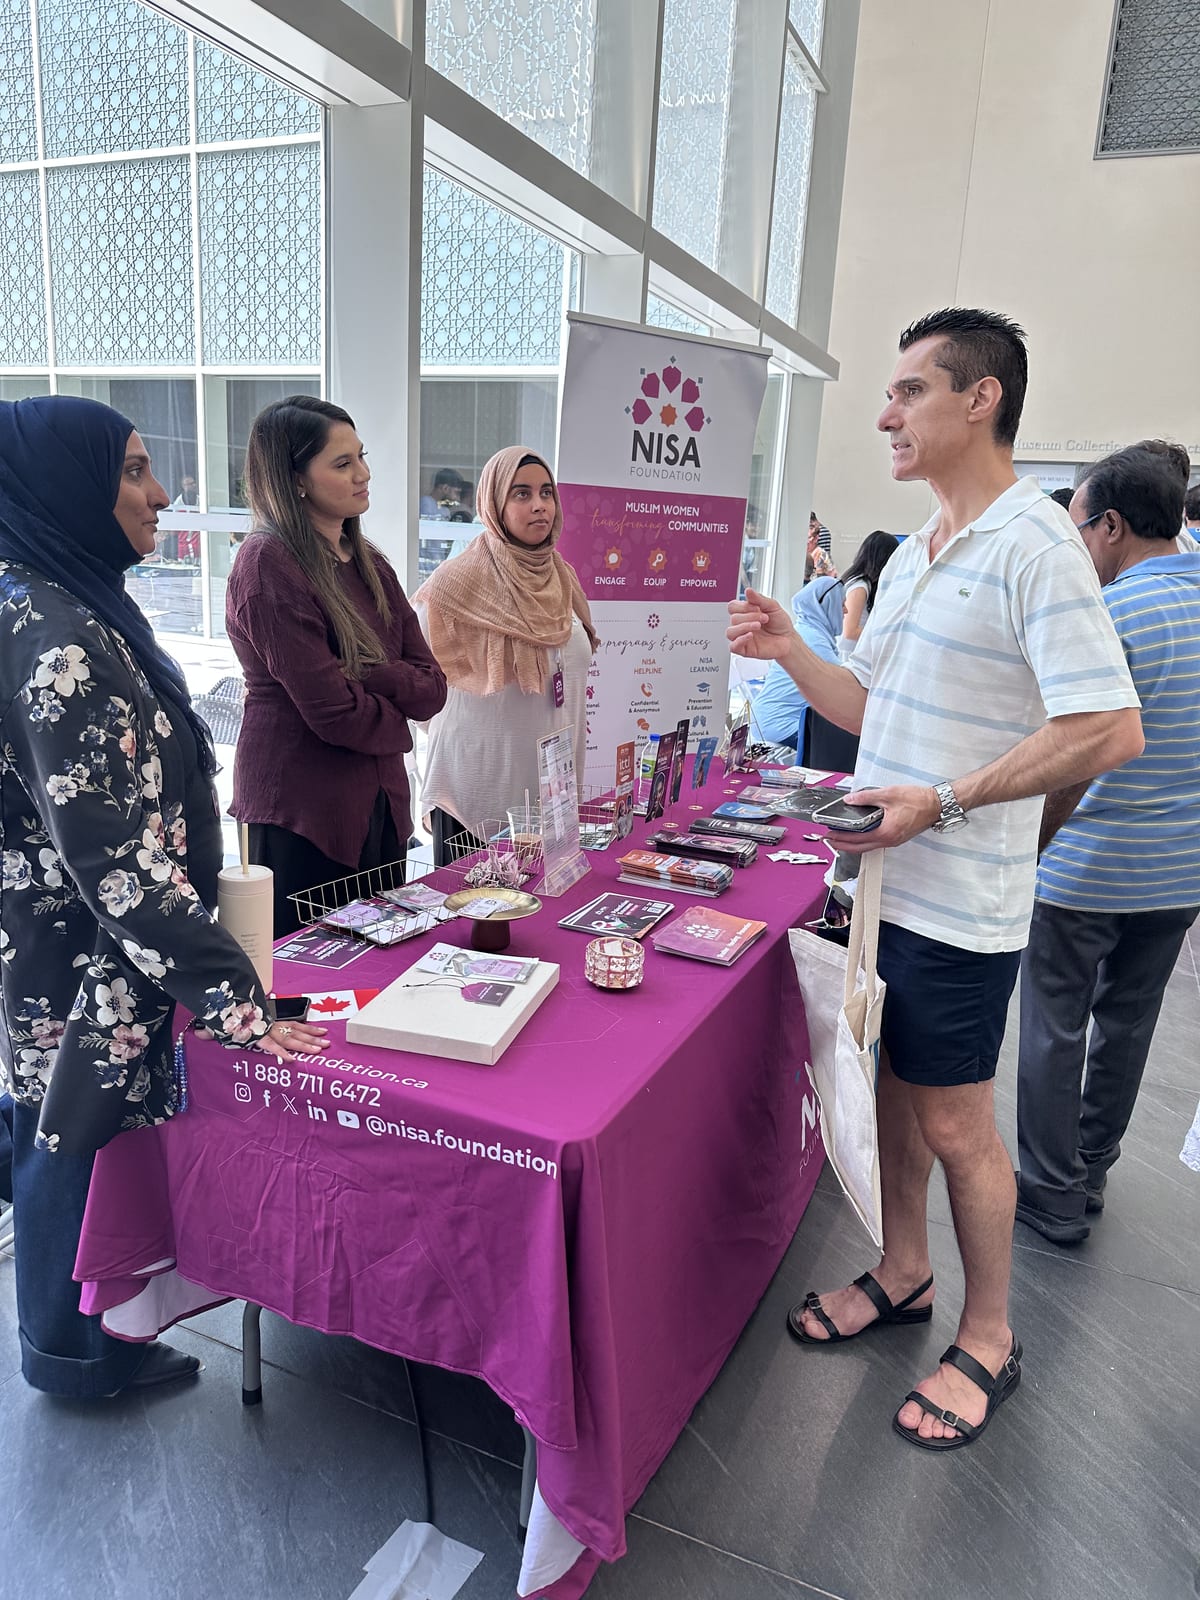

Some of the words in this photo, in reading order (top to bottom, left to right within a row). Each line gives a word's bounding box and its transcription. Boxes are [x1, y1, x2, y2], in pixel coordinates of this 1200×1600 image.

[631, 429, 701, 468] NISA
[629, 466, 701, 483] FOUNDATION
[625, 502, 661, 514] MUSLIM
[662, 504, 700, 517] WOMEN
[591, 508, 667, 537] transforming
[668, 520, 729, 534] COMMUNITIES
[594, 576, 626, 586] ENGAGE
[643, 577, 667, 587] EQUIP
[680, 578, 717, 588] EMPOWER
[606, 639, 656, 655] programs
[670, 638, 711, 651] services
[633, 667, 663, 675] HELPLINE
[689, 665, 720, 673] LEARNING
[240, 1046, 429, 1089] oundation.ca
[232, 1060, 250, 1078] +1
[254, 1063, 292, 1088] 888
[296, 1072, 324, 1096] 711
[330, 1081, 381, 1108] 6472
[365, 1115, 558, 1180] @nisa.foundation
